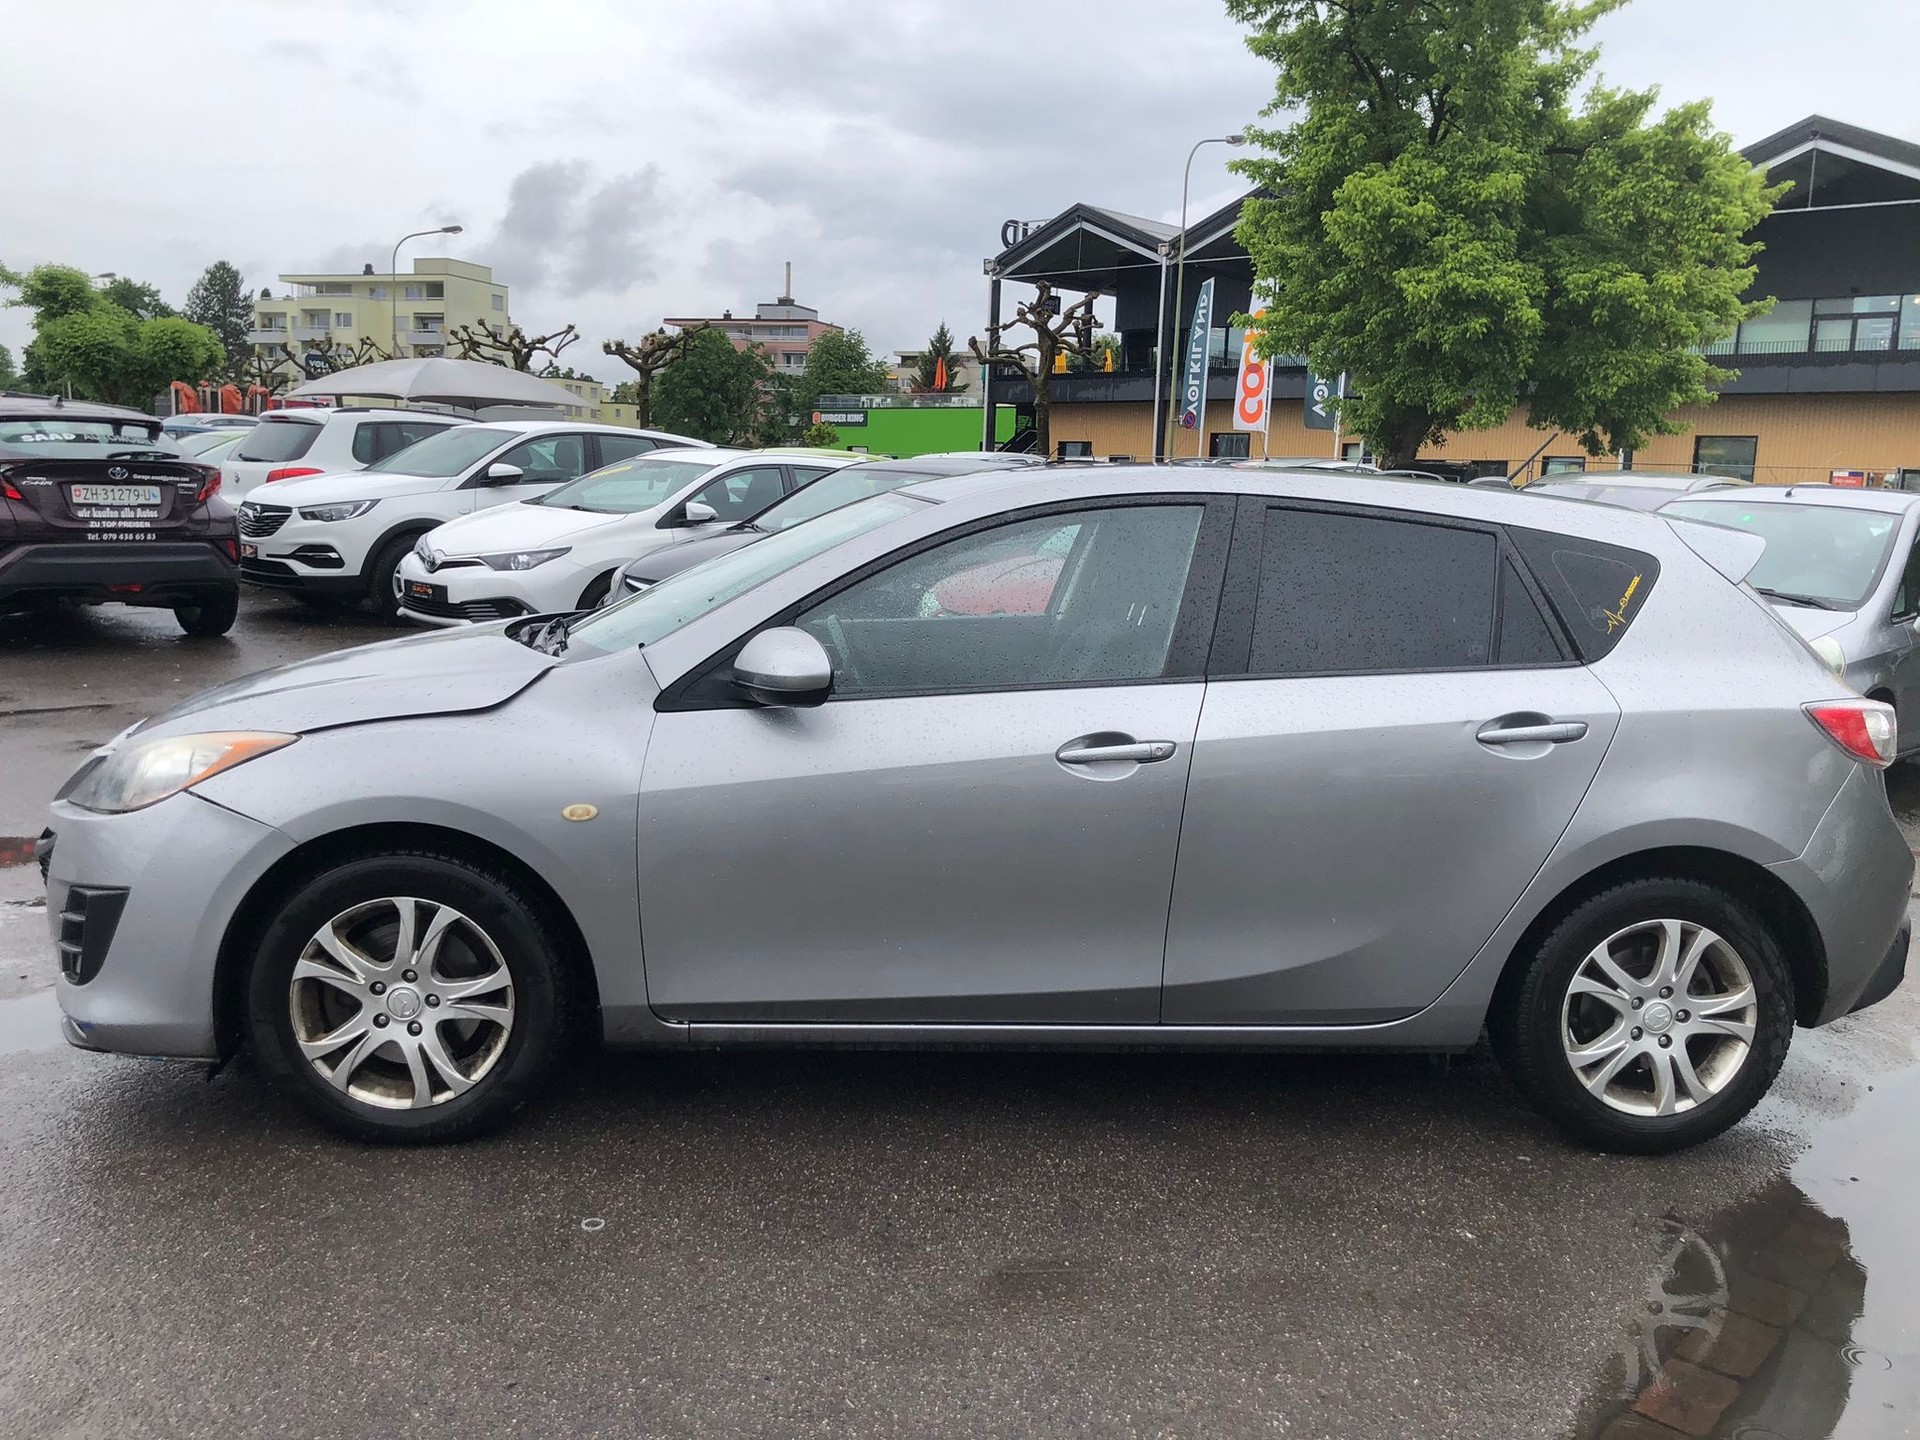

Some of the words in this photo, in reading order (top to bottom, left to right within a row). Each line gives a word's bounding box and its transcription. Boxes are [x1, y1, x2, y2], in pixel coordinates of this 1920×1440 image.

[820, 413, 847, 422] BURGER
[847, 413, 865, 422] KING
[20, 433, 77, 442] SAAD
